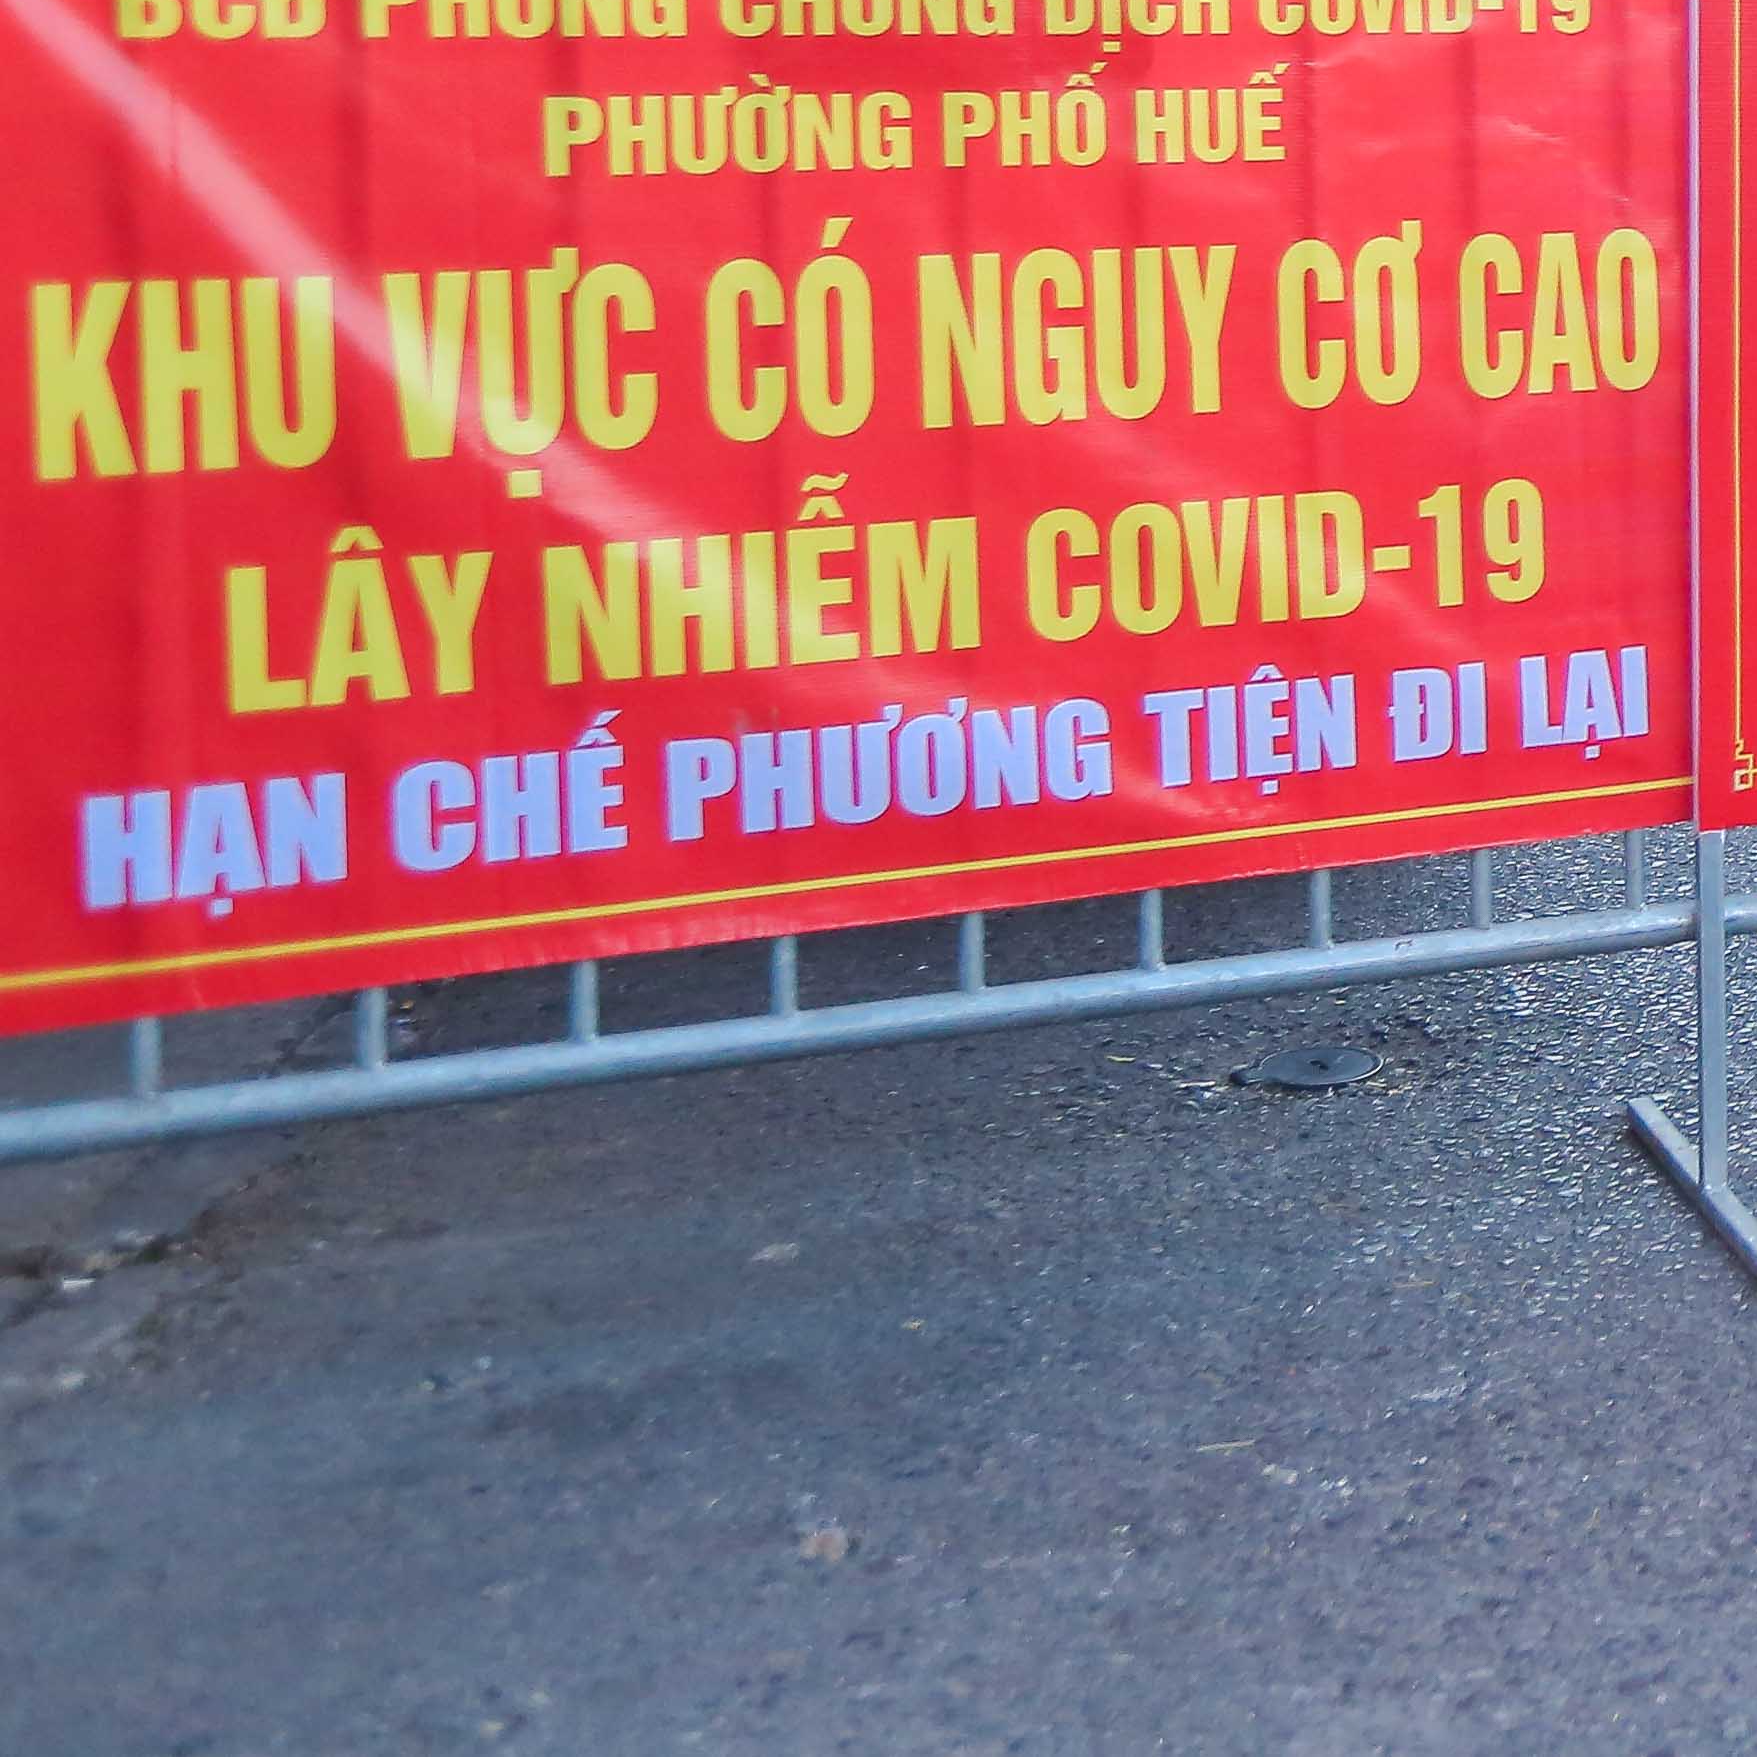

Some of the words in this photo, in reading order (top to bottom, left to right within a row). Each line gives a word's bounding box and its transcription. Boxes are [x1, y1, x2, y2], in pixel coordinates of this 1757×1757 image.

[543, 73, 915, 177] PHƯỜNG
[941, 62, 1107, 169] PHỐ
[1136, 63, 1289, 164] HUẾ
[33, 274, 337, 482] KHU
[383, 246, 660, 499] VỰC
[705, 217, 876, 444] CÓ
[918, 244, 1237, 430] NGUY
[1277, 220, 1422, 410] CƠ
[1459, 228, 1661, 401] CAO
[226, 525, 493, 715] LÂY
[543, 473, 981, 687] NHIỄM
[1026, 478, 1547, 643] COVID-19
[81, 773, 348, 918] HẠN
[393, 710, 628, 874] CHẾ
[664, 695, 1114, 842] PHƯƠNG
[1144, 664, 1357, 796] TIỆN
[1388, 660, 1488, 763] ĐI
[1519, 645, 1649, 760] LẠI
